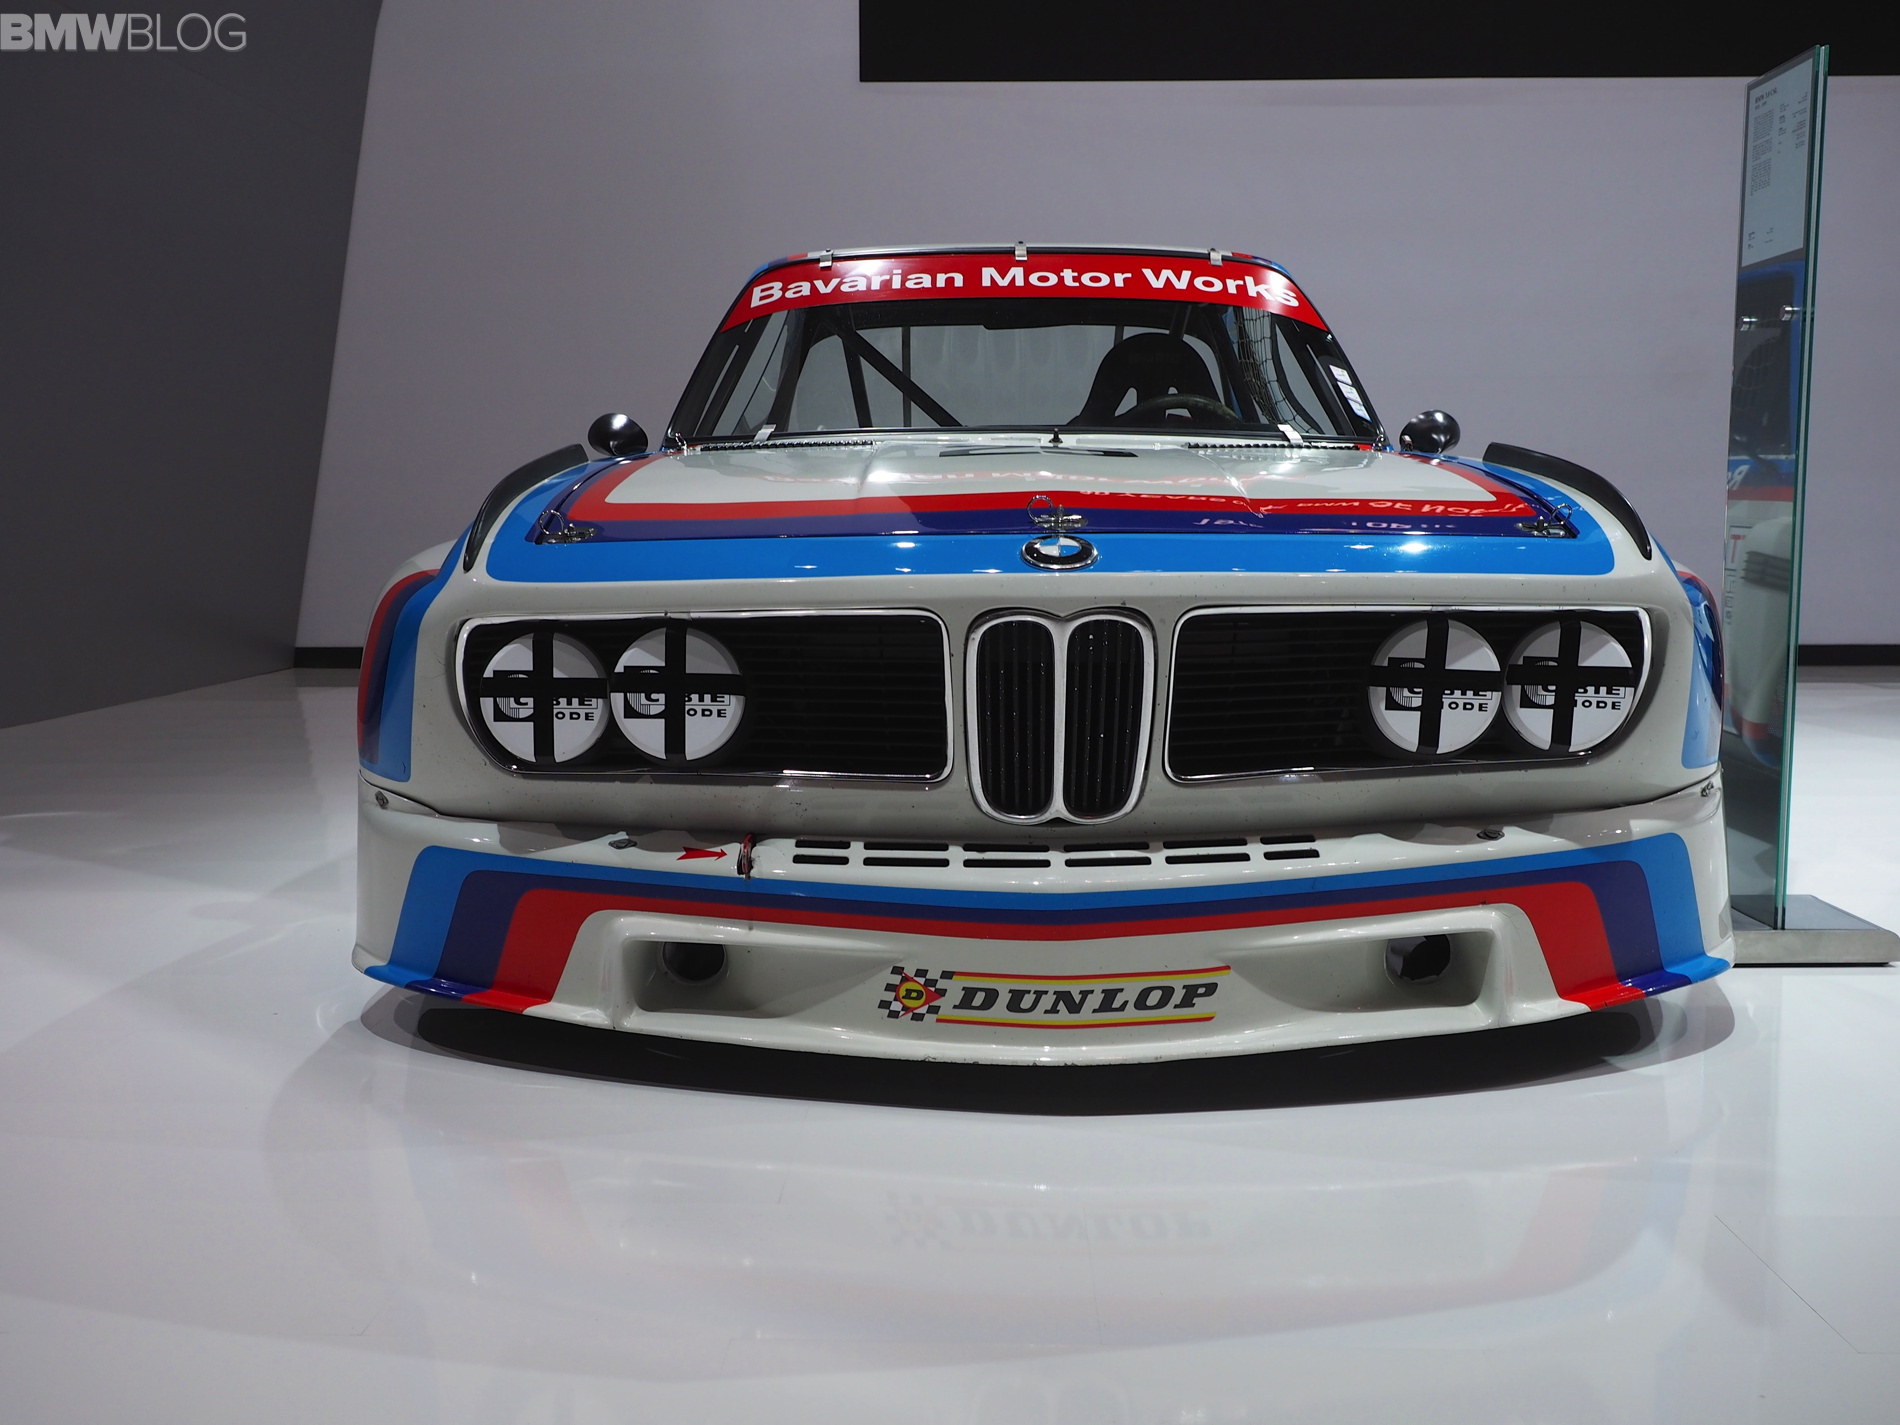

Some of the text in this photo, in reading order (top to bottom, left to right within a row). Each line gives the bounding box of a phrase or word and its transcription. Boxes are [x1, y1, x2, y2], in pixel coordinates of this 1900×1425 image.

[750, 266, 1300, 308] Bavarian Motor Works
[1447, 701, 1488, 712] ODE
[1581, 699, 1621, 710] ODE
[554, 711, 595, 721] ODE
[686, 708, 727, 718] ODE
[952, 982, 1219, 1015] DUNLOP
